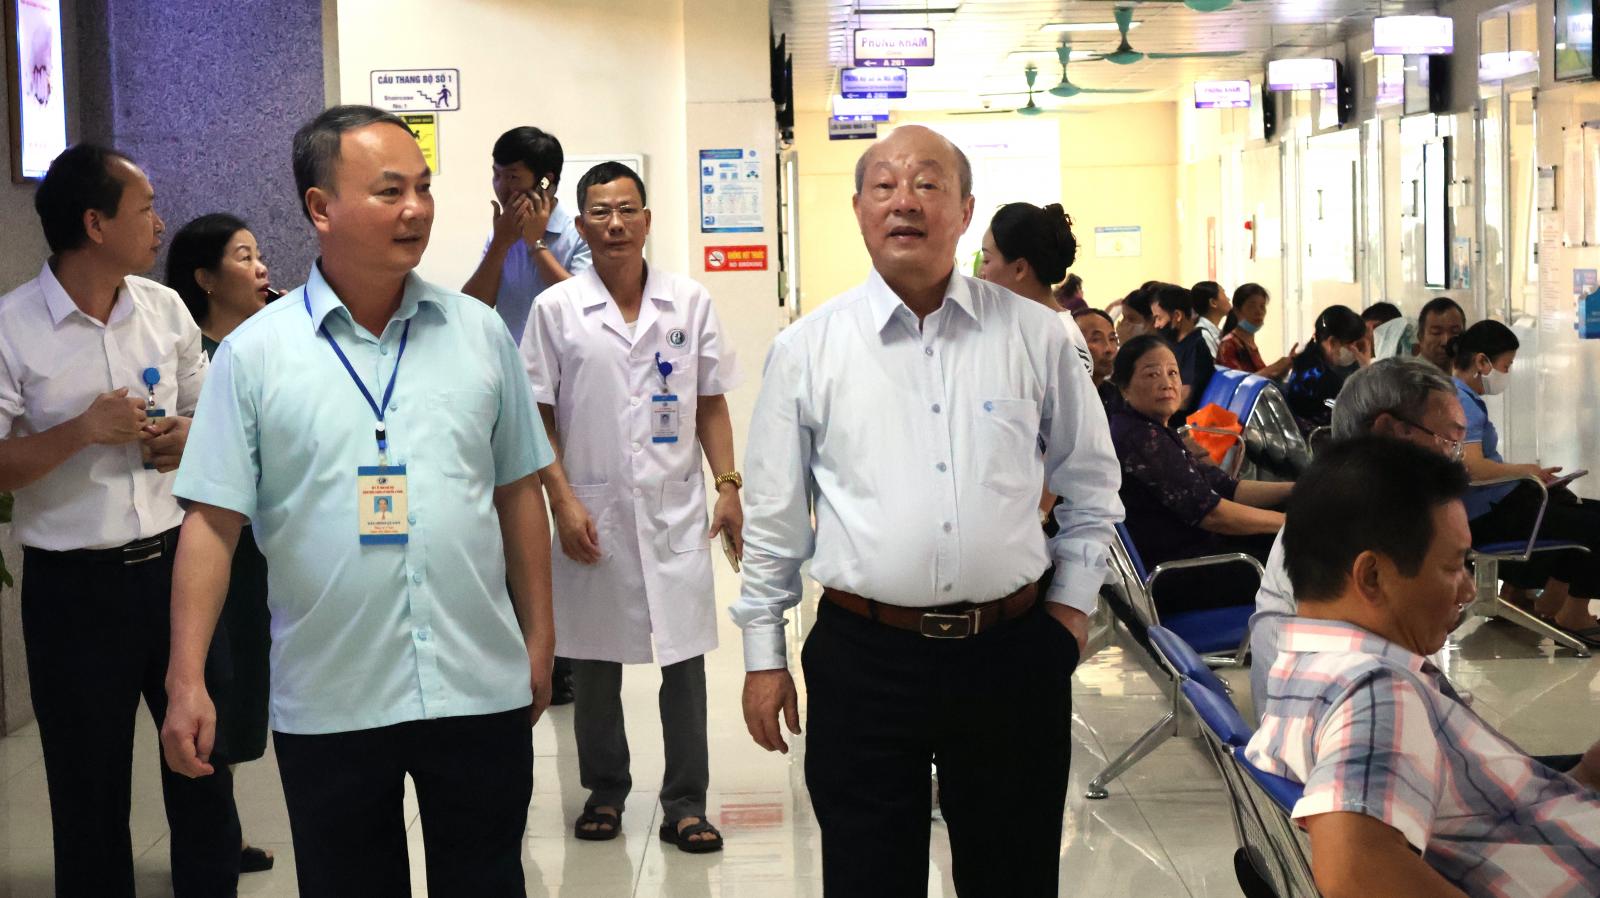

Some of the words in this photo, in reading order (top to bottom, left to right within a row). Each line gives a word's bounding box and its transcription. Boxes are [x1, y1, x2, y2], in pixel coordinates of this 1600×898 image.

[395, 74, 420, 84] THANG
[422, 74, 433, 85] BỘ
[436, 74, 446, 83] SỐ
